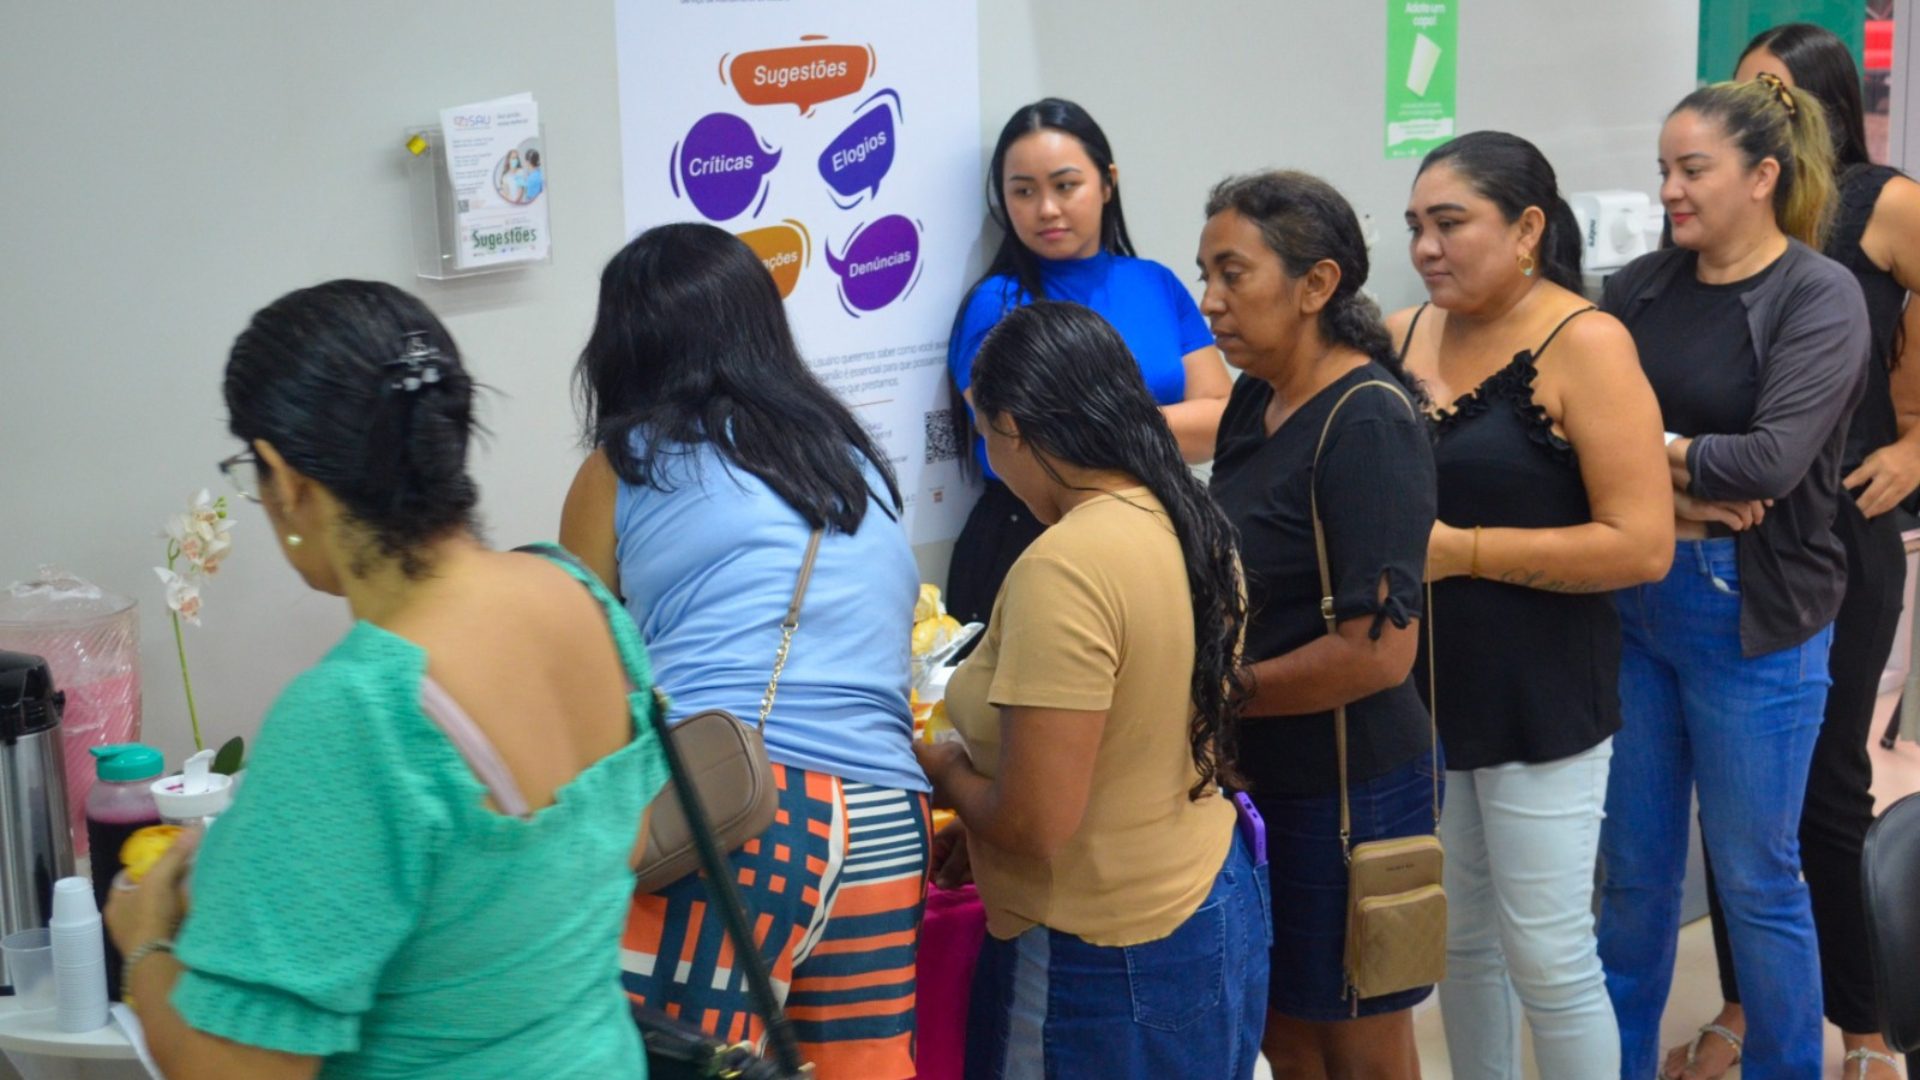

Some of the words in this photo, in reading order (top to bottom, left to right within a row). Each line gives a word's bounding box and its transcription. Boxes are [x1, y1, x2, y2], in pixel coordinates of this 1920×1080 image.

[753, 59, 847, 88] Sugestões
[688, 150, 755, 177] Críticas
[832, 130, 888, 173] Elogios
[471, 226, 538, 250] Sugestões
[762, 250, 799, 272] ações
[848, 247, 912, 278] Denúncias
